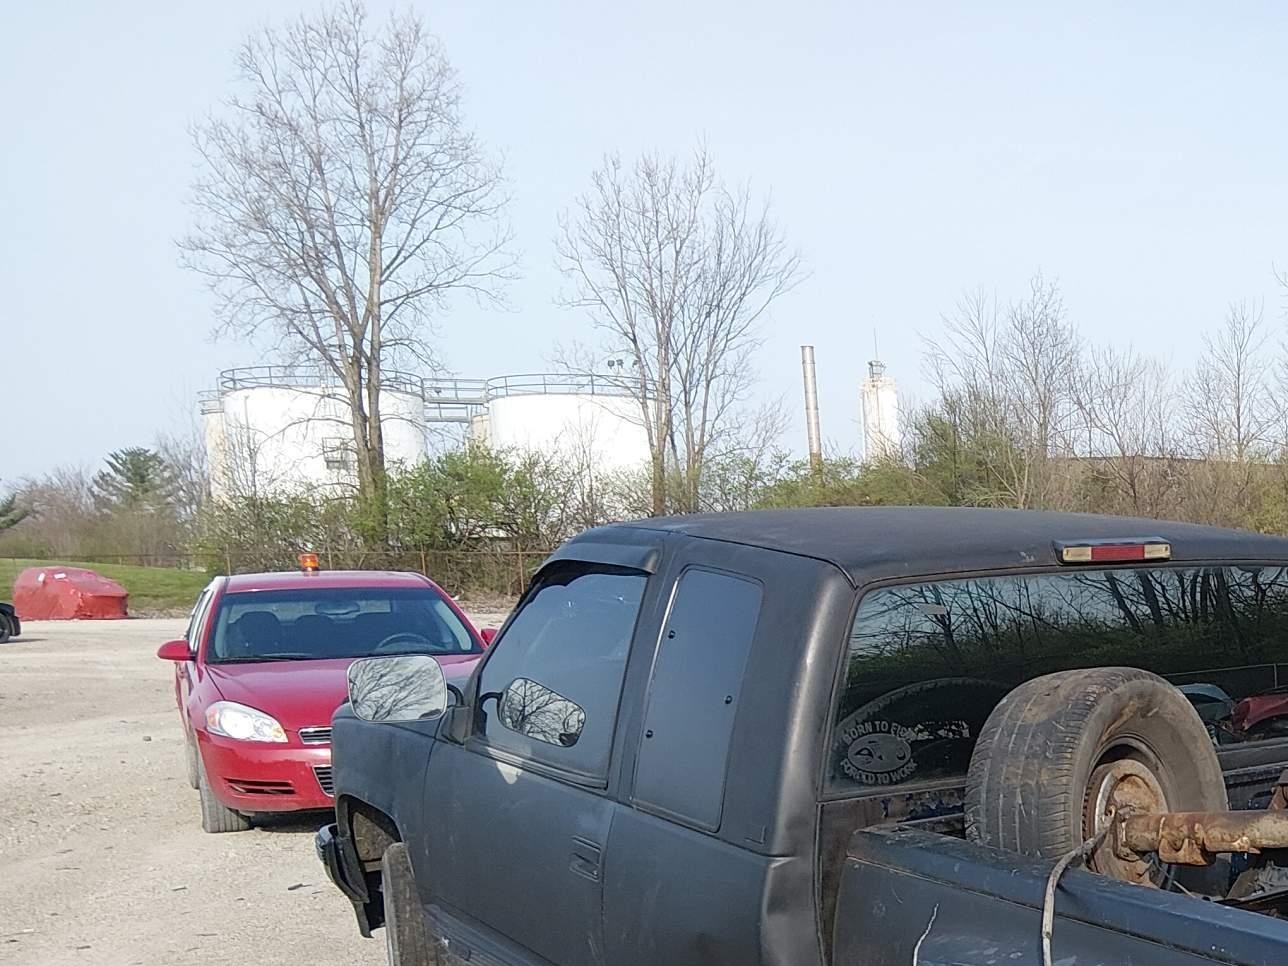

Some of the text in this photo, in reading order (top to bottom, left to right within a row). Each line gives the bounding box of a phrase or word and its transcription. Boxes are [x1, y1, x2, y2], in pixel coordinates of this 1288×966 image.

[842, 721, 873, 744] BORN
[874, 720, 889, 732] TO
[840, 758, 918, 785] FORCED TO WORK
